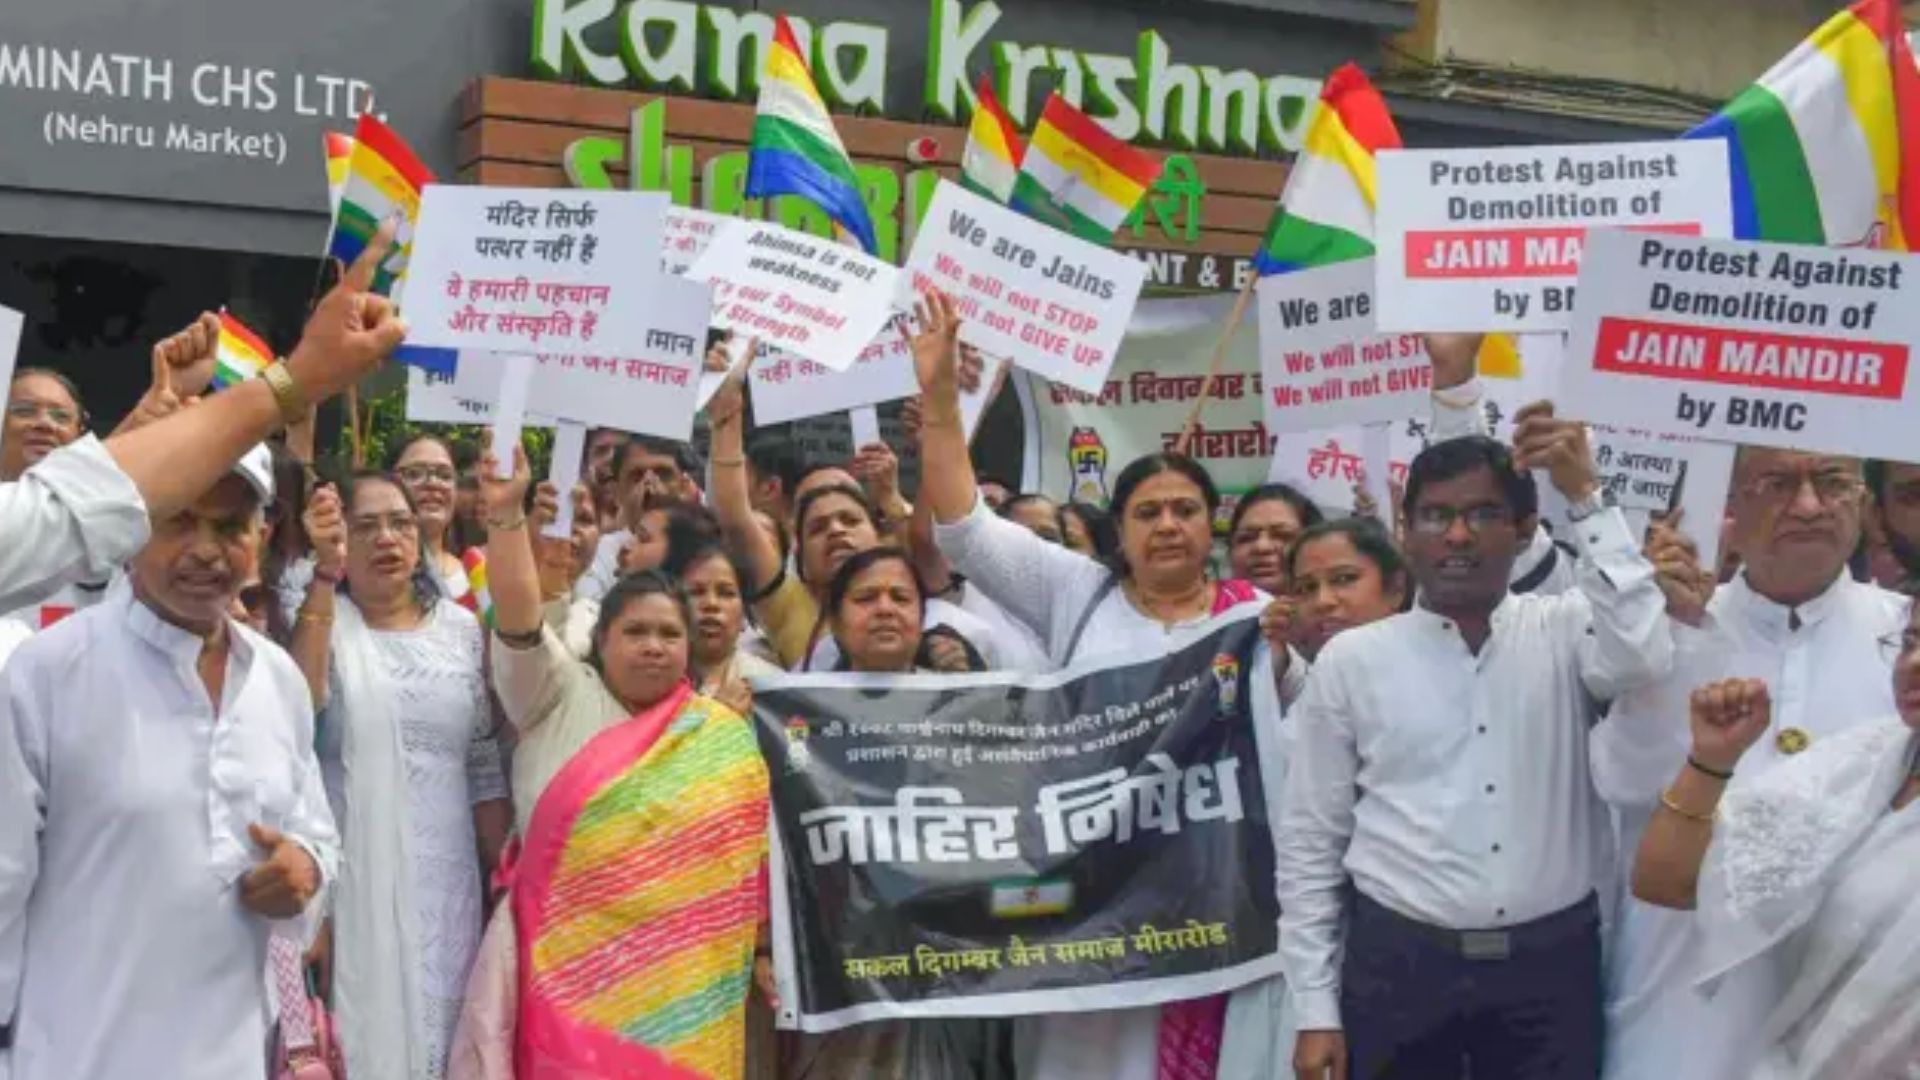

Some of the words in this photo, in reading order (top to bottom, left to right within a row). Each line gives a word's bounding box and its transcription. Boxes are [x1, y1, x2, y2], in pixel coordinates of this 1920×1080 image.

[191, 64, 277, 111] CHS
[295, 75, 387, 122] LTD.
[44, 112, 154, 147] (Nehru
[166, 123, 287, 165] Market)
[1431, 160, 1544, 187] Protest
[1555, 154, 1678, 185] Against
[486, 201, 540, 229] मंदिर
[546, 201, 597, 229] सिर्फ
[1448, 193, 1618, 221] Demolition
[1631, 191, 1661, 215] of
[475, 236, 526, 260] पत्थर
[533, 234, 577, 262] नहीं
[747, 230, 817, 260] Ahimsa
[820, 245, 840, 267] is
[842, 254, 878, 283] not
[948, 208, 988, 247] We
[992, 236, 1037, 269] are
[1041, 255, 1116, 300] Jains
[1424, 237, 1510, 270] JAIN
[1524, 236, 1584, 269] MA
[1640, 239, 1760, 279] Protest
[1769, 252, 1902, 291] Against
[447, 272, 462, 299] वे
[468, 275, 530, 302] हमारी
[536, 284, 610, 306] पहचान
[747, 255, 843, 294] weakness
[1198, 255, 1220, 288] &
[773, 292, 849, 331] Symbol
[934, 252, 964, 283] We
[968, 269, 1003, 301] will
[1007, 291, 1041, 317] not
[1043, 303, 1099, 335] STOP
[1279, 298, 1318, 330] We
[1328, 292, 1370, 320] are
[1494, 288, 1530, 319] by
[1651, 283, 1827, 326] Demolition
[1840, 302, 1877, 330] of
[448, 305, 489, 333] और
[497, 309, 574, 342] संस्कृति
[727, 303, 811, 343] Strength
[982, 311, 1017, 336] not
[1020, 323, 1070, 356] GIVE
[1072, 343, 1105, 367] UP
[625, 359, 691, 387] समाज
[1283, 350, 1315, 375] We
[1320, 343, 1355, 369] will
[1362, 338, 1393, 364] not
[1399, 334, 1428, 357] ST
[1615, 330, 1706, 368] JAIN
[1718, 339, 1884, 386] MANDIR
[1273, 386, 1303, 409] We
[1308, 378, 1343, 403] will
[1350, 374, 1381, 398] not
[1676, 394, 1716, 428] by
[1726, 396, 1808, 431] BMC
[800, 785, 1019, 866] जाहिर
[1035, 753, 1245, 855] निषेध
[844, 953, 911, 980] सकल
[915, 944, 1003, 978] दिगम्बर
[1007, 933, 1048, 968] जैन
[1054, 936, 1126, 964] समाज
[1130, 918, 1228, 955] मीरारोड
